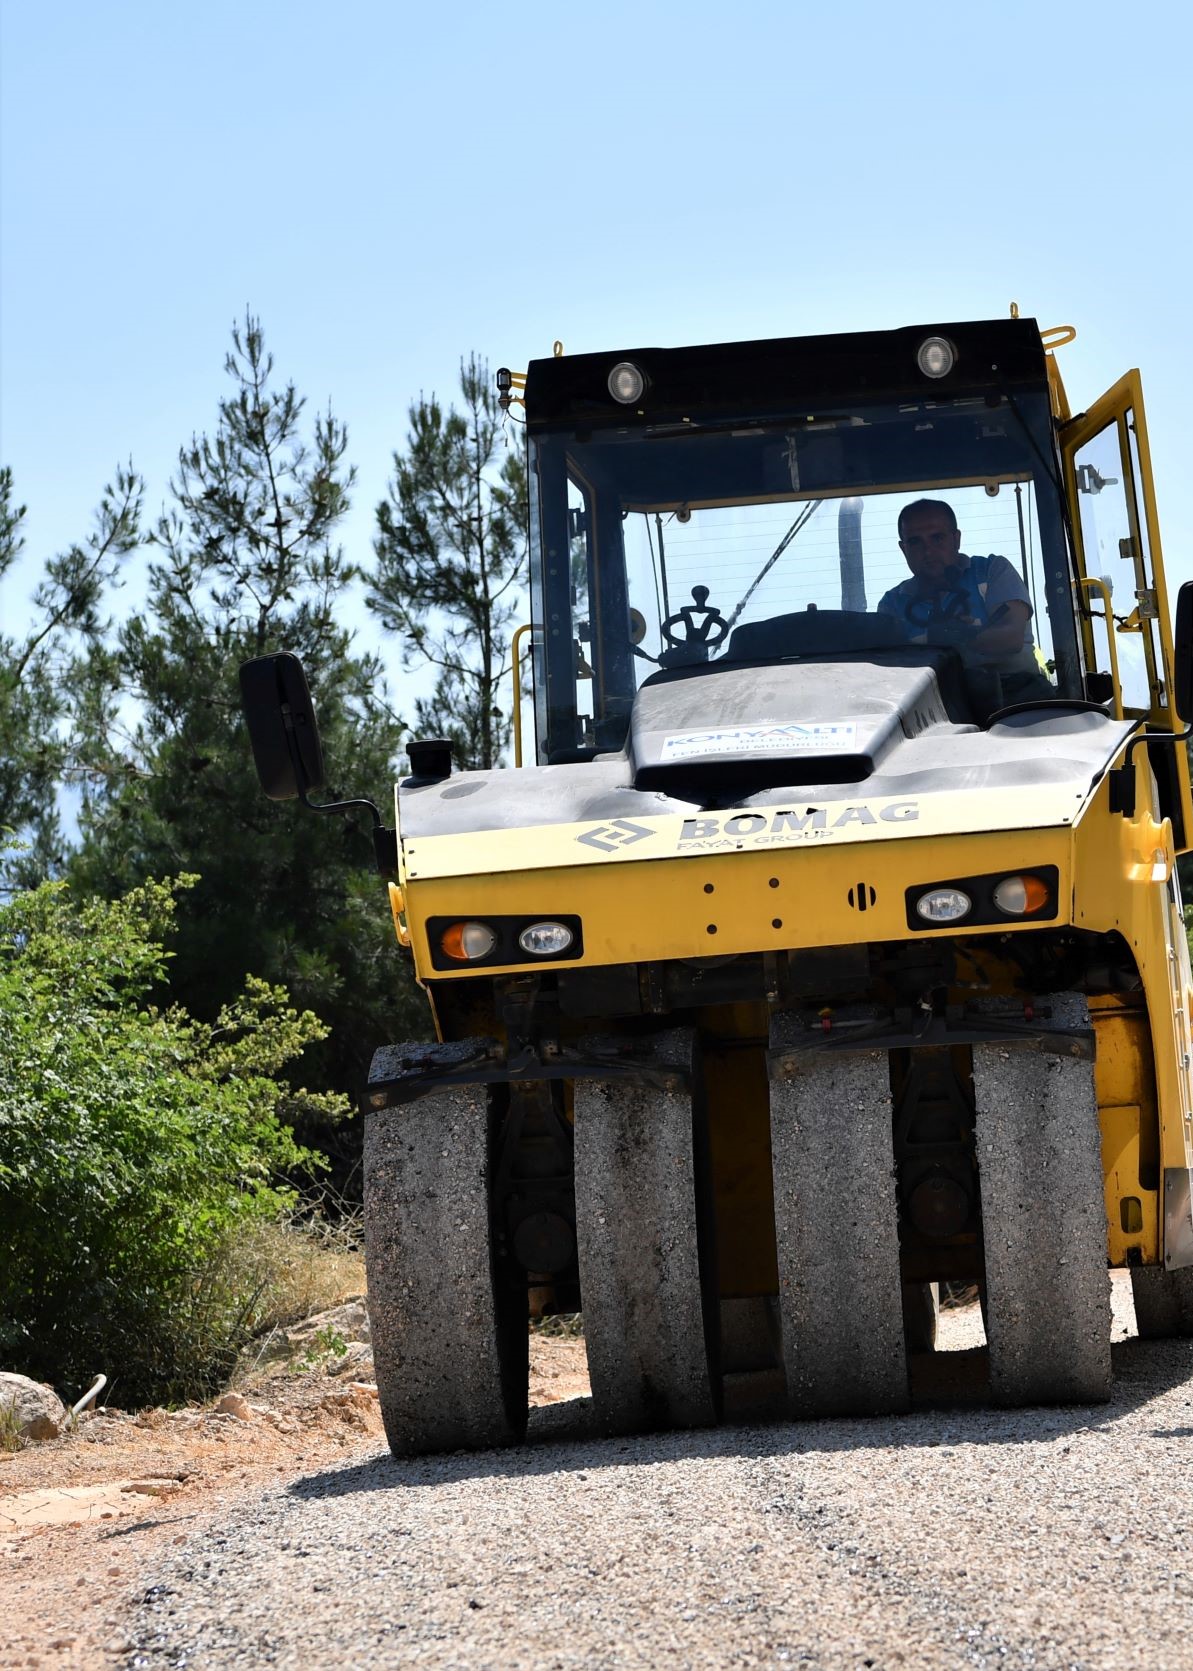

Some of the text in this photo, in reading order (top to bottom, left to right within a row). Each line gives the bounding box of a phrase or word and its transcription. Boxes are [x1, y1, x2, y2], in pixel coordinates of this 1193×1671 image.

[679, 801, 920, 841] BOMAG
[676, 830, 835, 851] FAYAT GROUP
